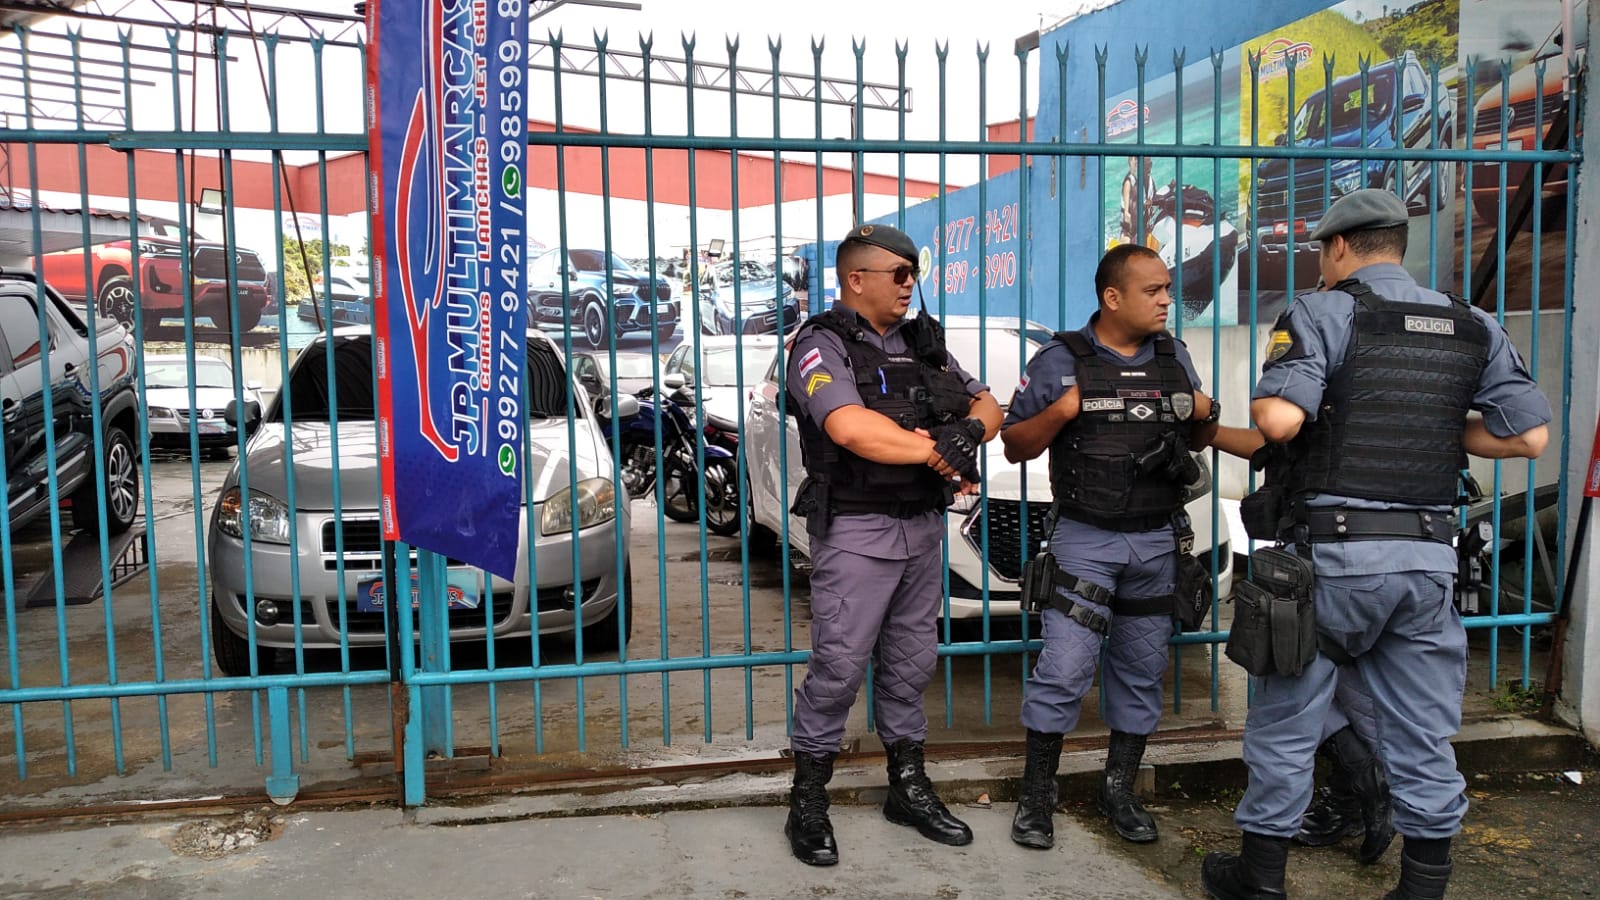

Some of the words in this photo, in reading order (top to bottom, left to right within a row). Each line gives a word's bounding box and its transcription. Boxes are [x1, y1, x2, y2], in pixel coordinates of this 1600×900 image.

[474, 53, 487, 108] JET
[476, 137, 491, 261] LANCHAS
[480, 291, 491, 391] CARROS
[498, 228, 521, 441] 99277-9421
